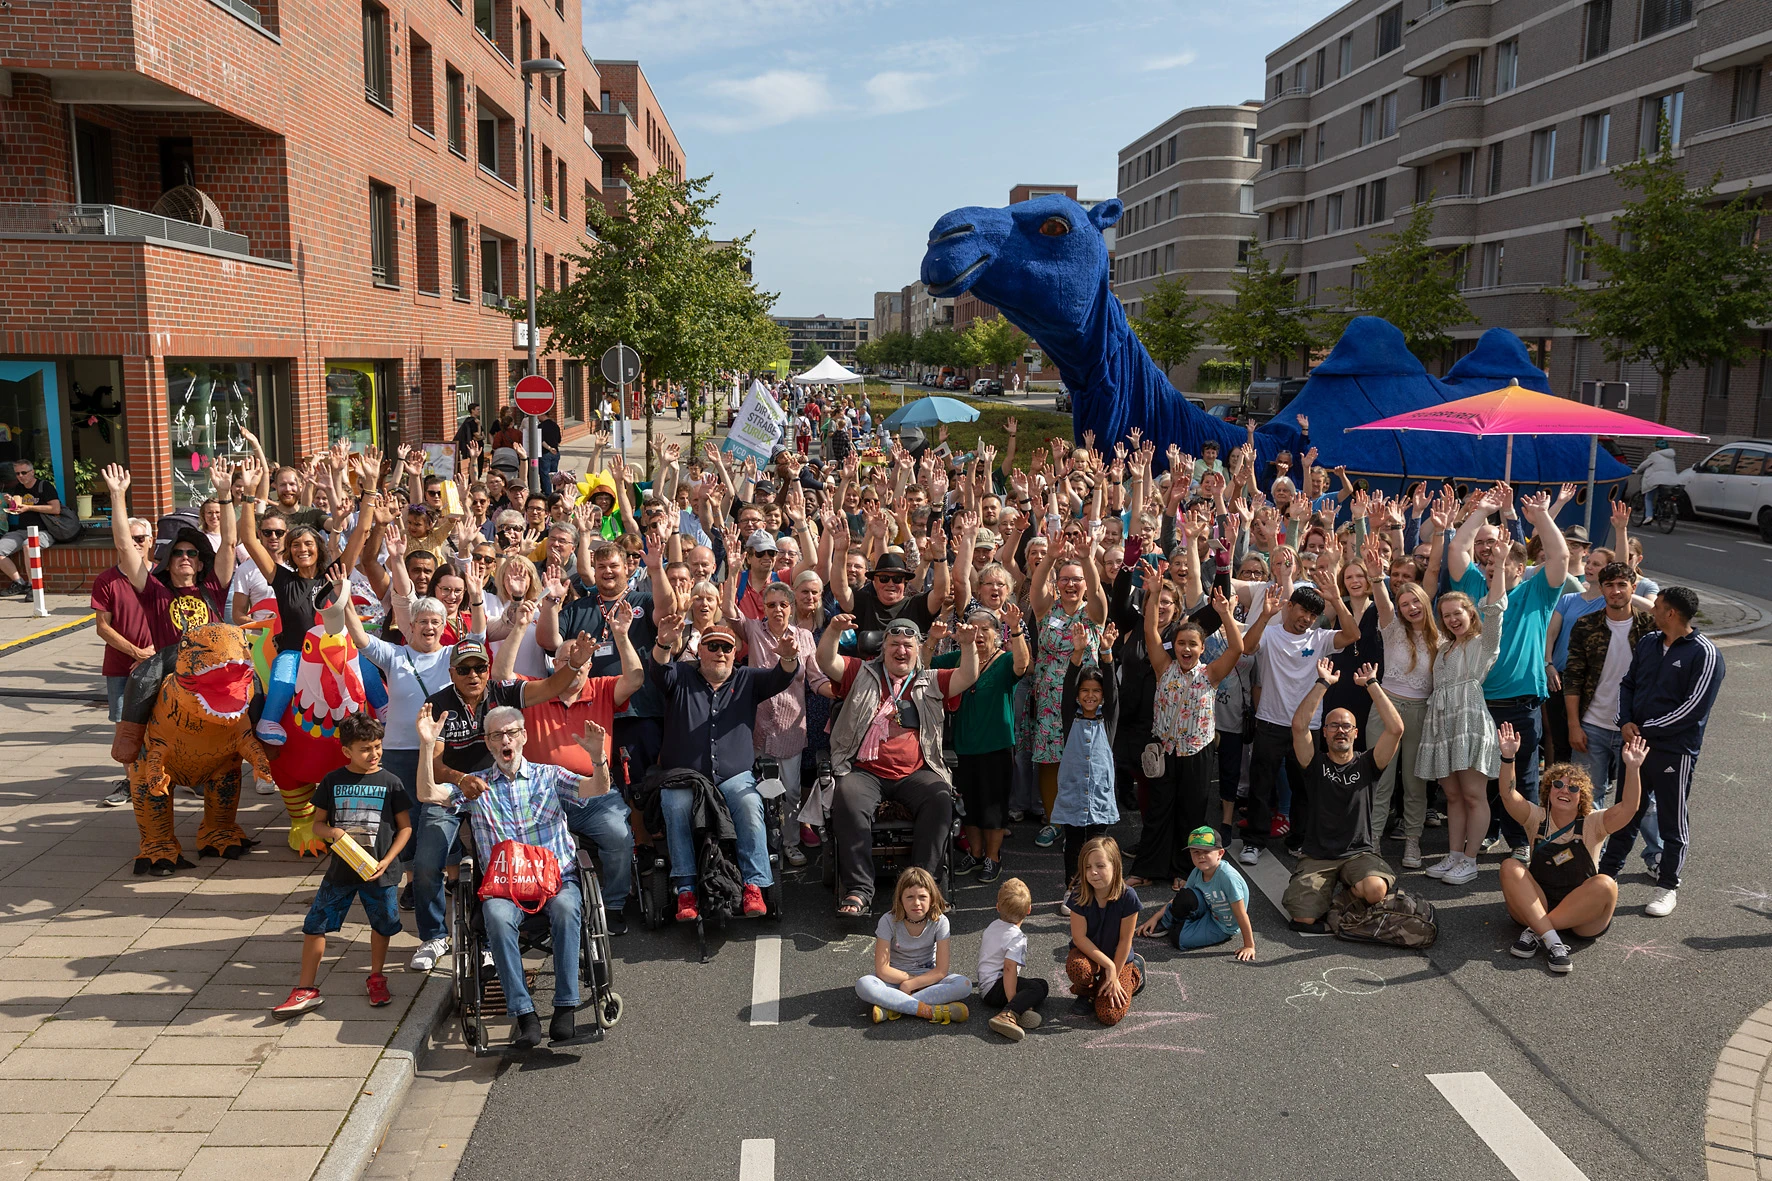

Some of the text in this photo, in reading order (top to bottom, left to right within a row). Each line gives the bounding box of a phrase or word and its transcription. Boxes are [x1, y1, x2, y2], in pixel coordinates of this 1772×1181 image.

[754, 402, 768, 417] DIR
[742, 422, 774, 446] ZURÜCK
[732, 444, 747, 457] VCD
[336, 785, 384, 796] BROOKLYN
